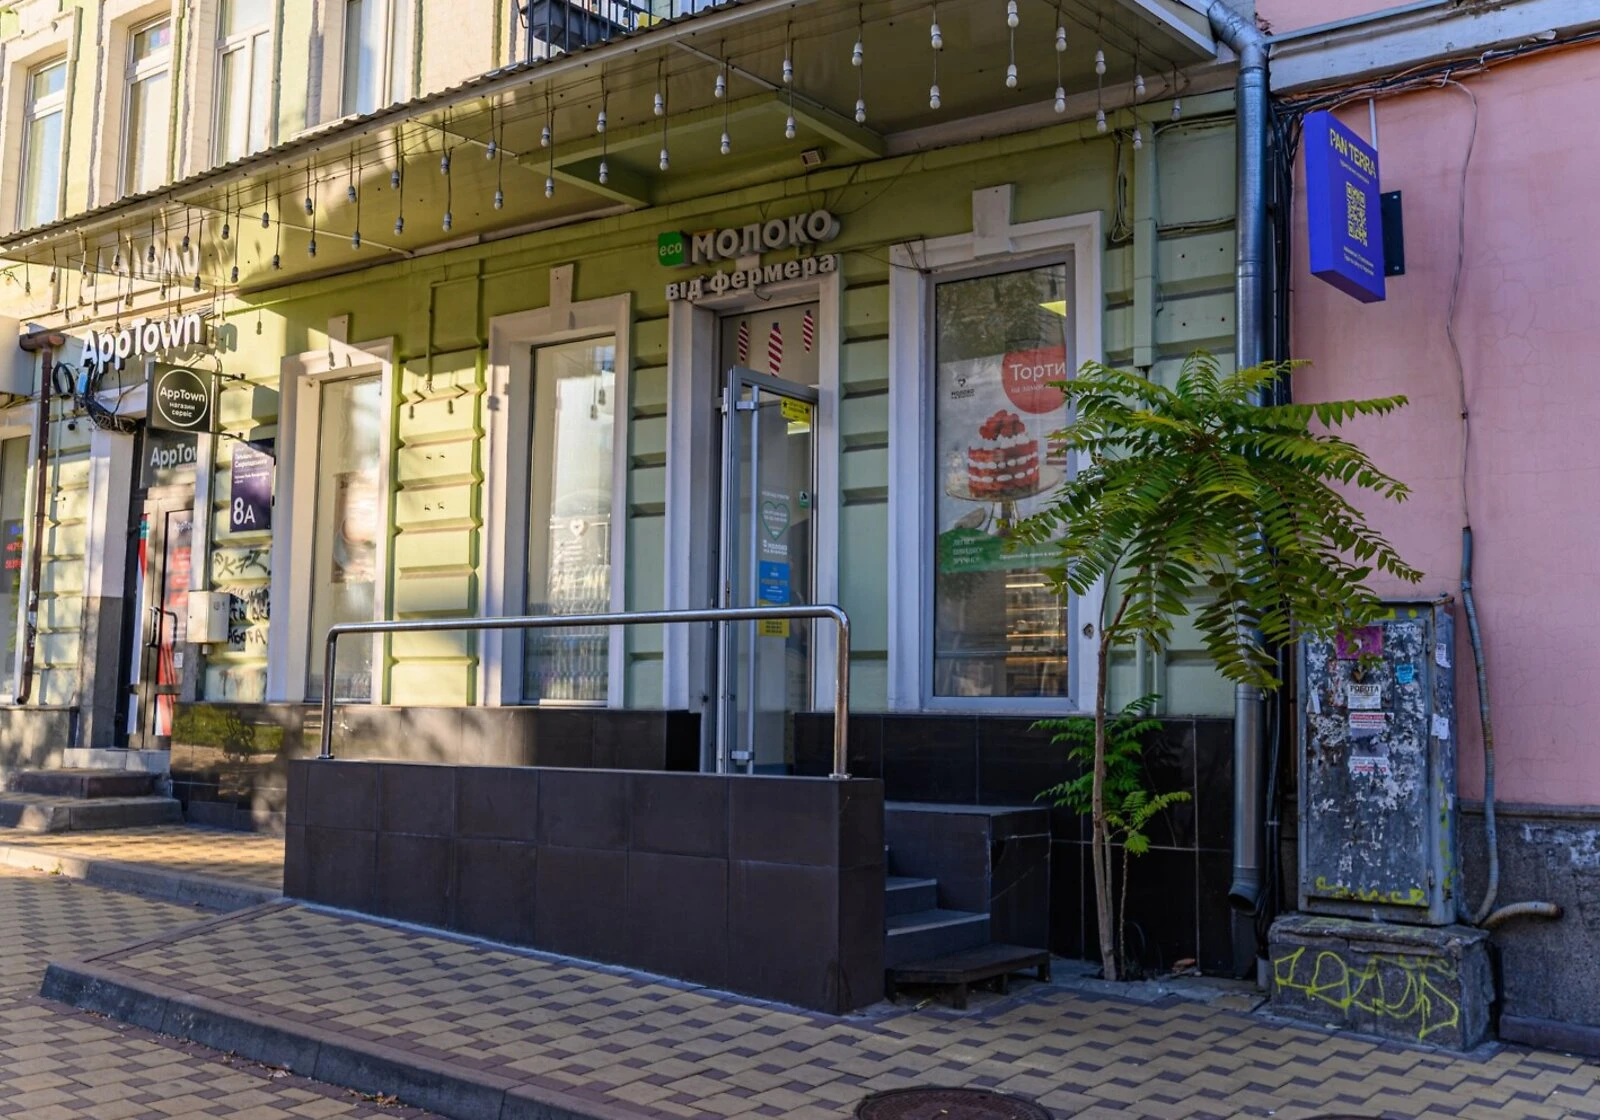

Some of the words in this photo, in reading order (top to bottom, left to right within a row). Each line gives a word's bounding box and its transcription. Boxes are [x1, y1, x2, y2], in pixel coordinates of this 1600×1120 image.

[1329, 128, 1348, 157] PAN
[1348, 142, 1377, 179] TERRA
[659, 241, 683, 257] eco
[691, 209, 834, 263] МОЛОКО
[665, 278, 703, 301] від
[710, 254, 836, 296] фермера
[80, 313, 201, 374] AppTown
[1009, 361, 1066, 382] Торти
[160, 386, 206, 402] AppTown
[171, 409, 193, 418] сервіс
